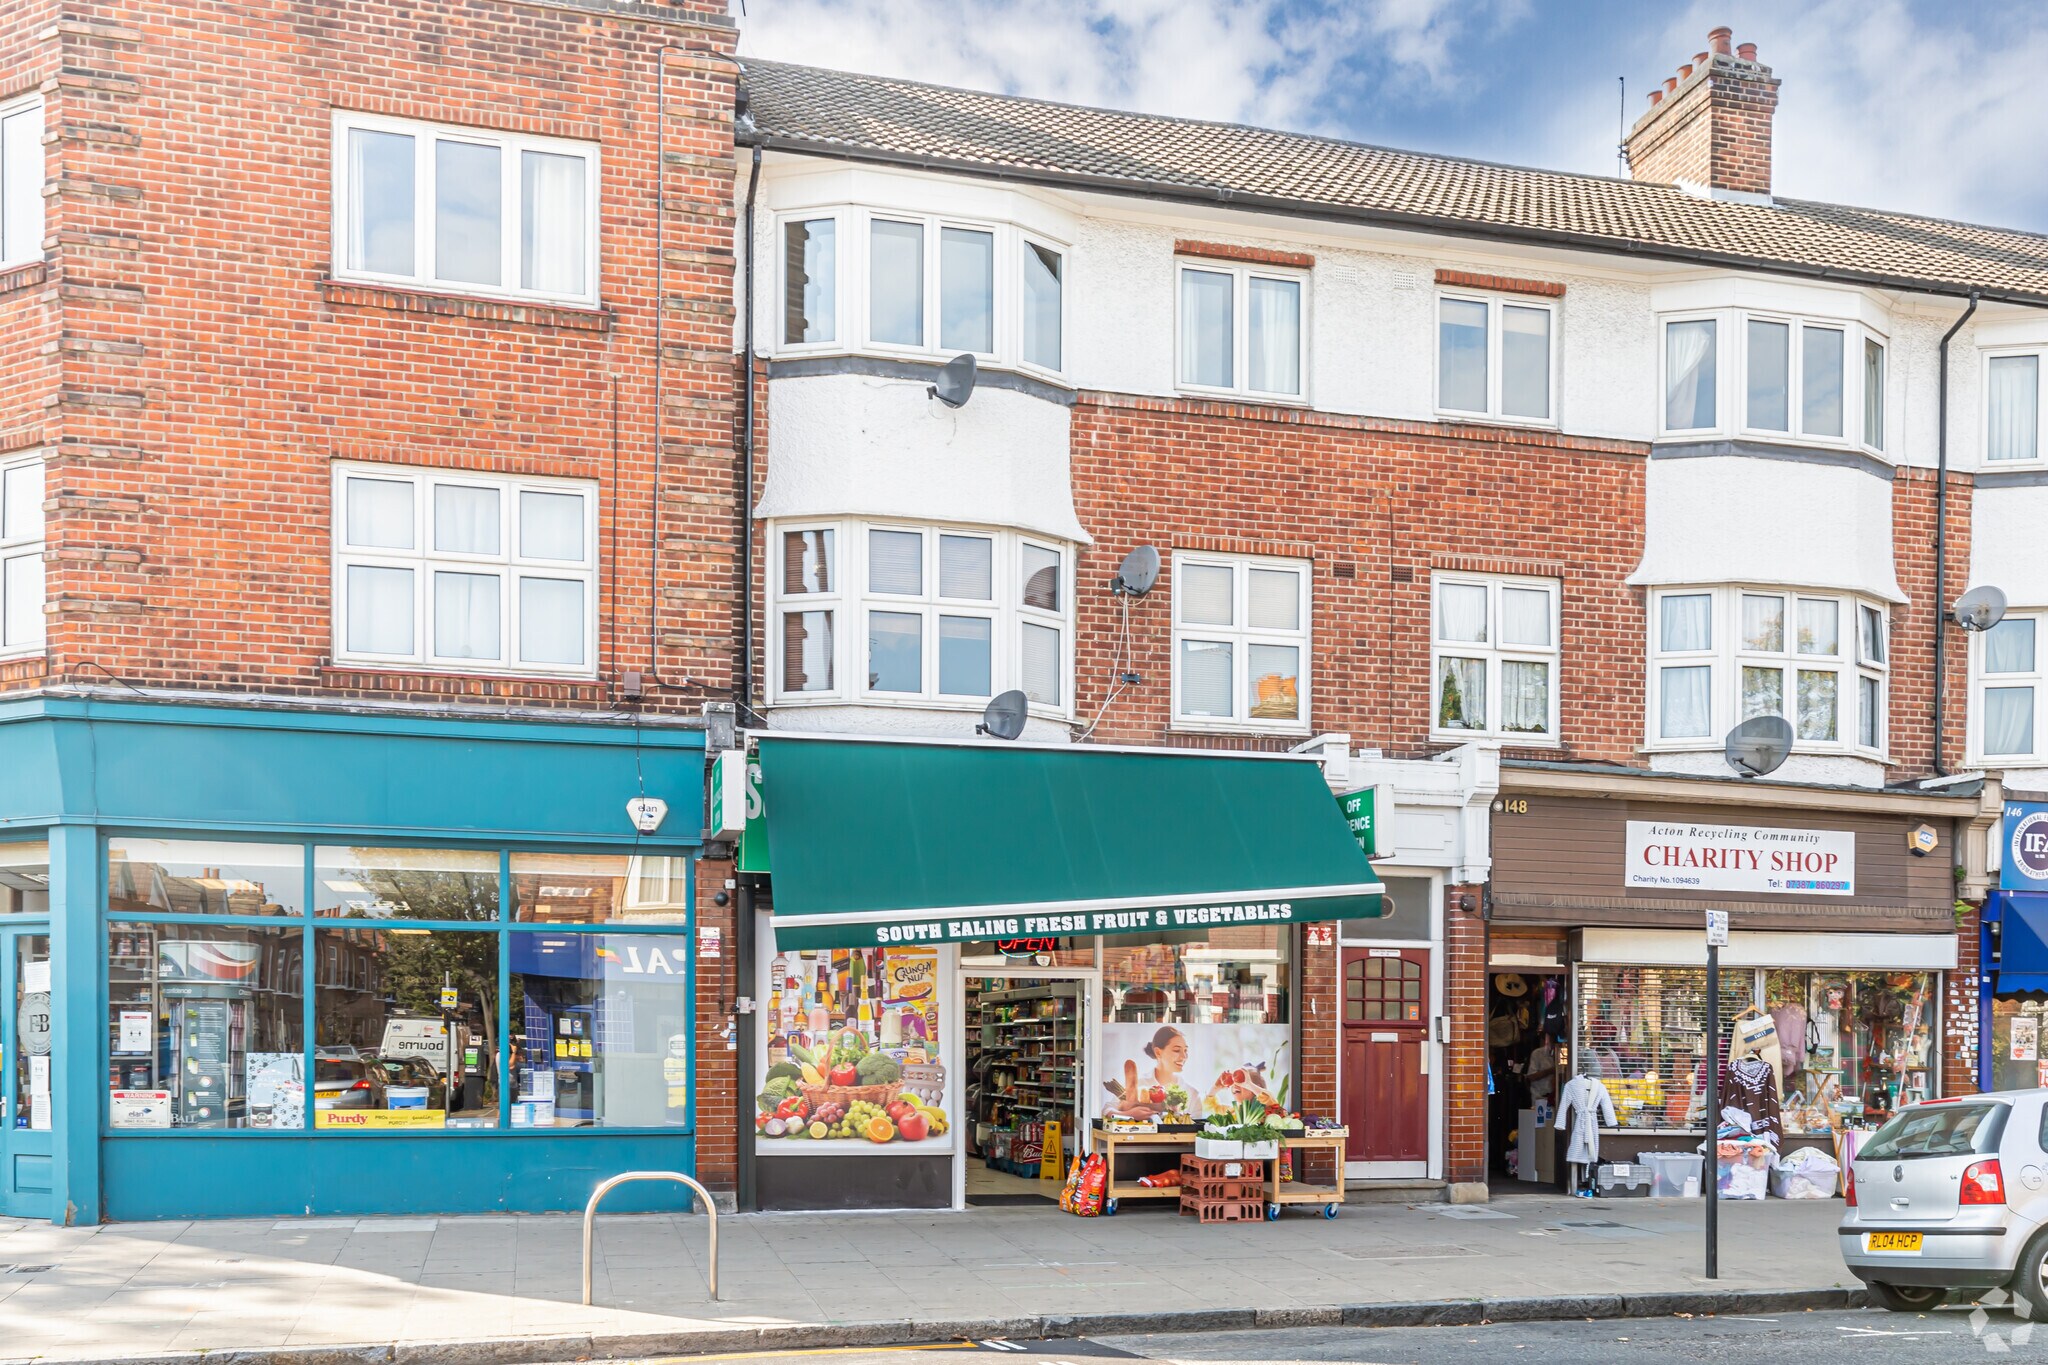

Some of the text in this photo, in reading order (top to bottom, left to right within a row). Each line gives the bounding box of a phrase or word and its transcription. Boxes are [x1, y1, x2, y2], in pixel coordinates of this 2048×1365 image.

[638, 804, 658, 812] elan
[1347, 798, 1361, 813] OFF
[1504, 799, 1528, 814] 148
[2006, 807, 2022, 817] 146
[1347, 816, 1370, 831] ENCE
[1648, 825, 1820, 845] Acton Recycling Community
[1643, 844, 1838, 873] CHARITY SHOP
[1632, 875, 1658, 884] Charity
[1768, 879, 1845, 890] Tel: 07387 860297
[876, 904, 1292, 942] SOUTH EALING FRESH FRUIT & VEGETABLES
[895, 961, 932, 982] CRUNCHY
[907, 973, 925, 983] NUT
[328, 1113, 368, 1124] Purdy
[1871, 1234, 1918, 1248] RL04 HCP
